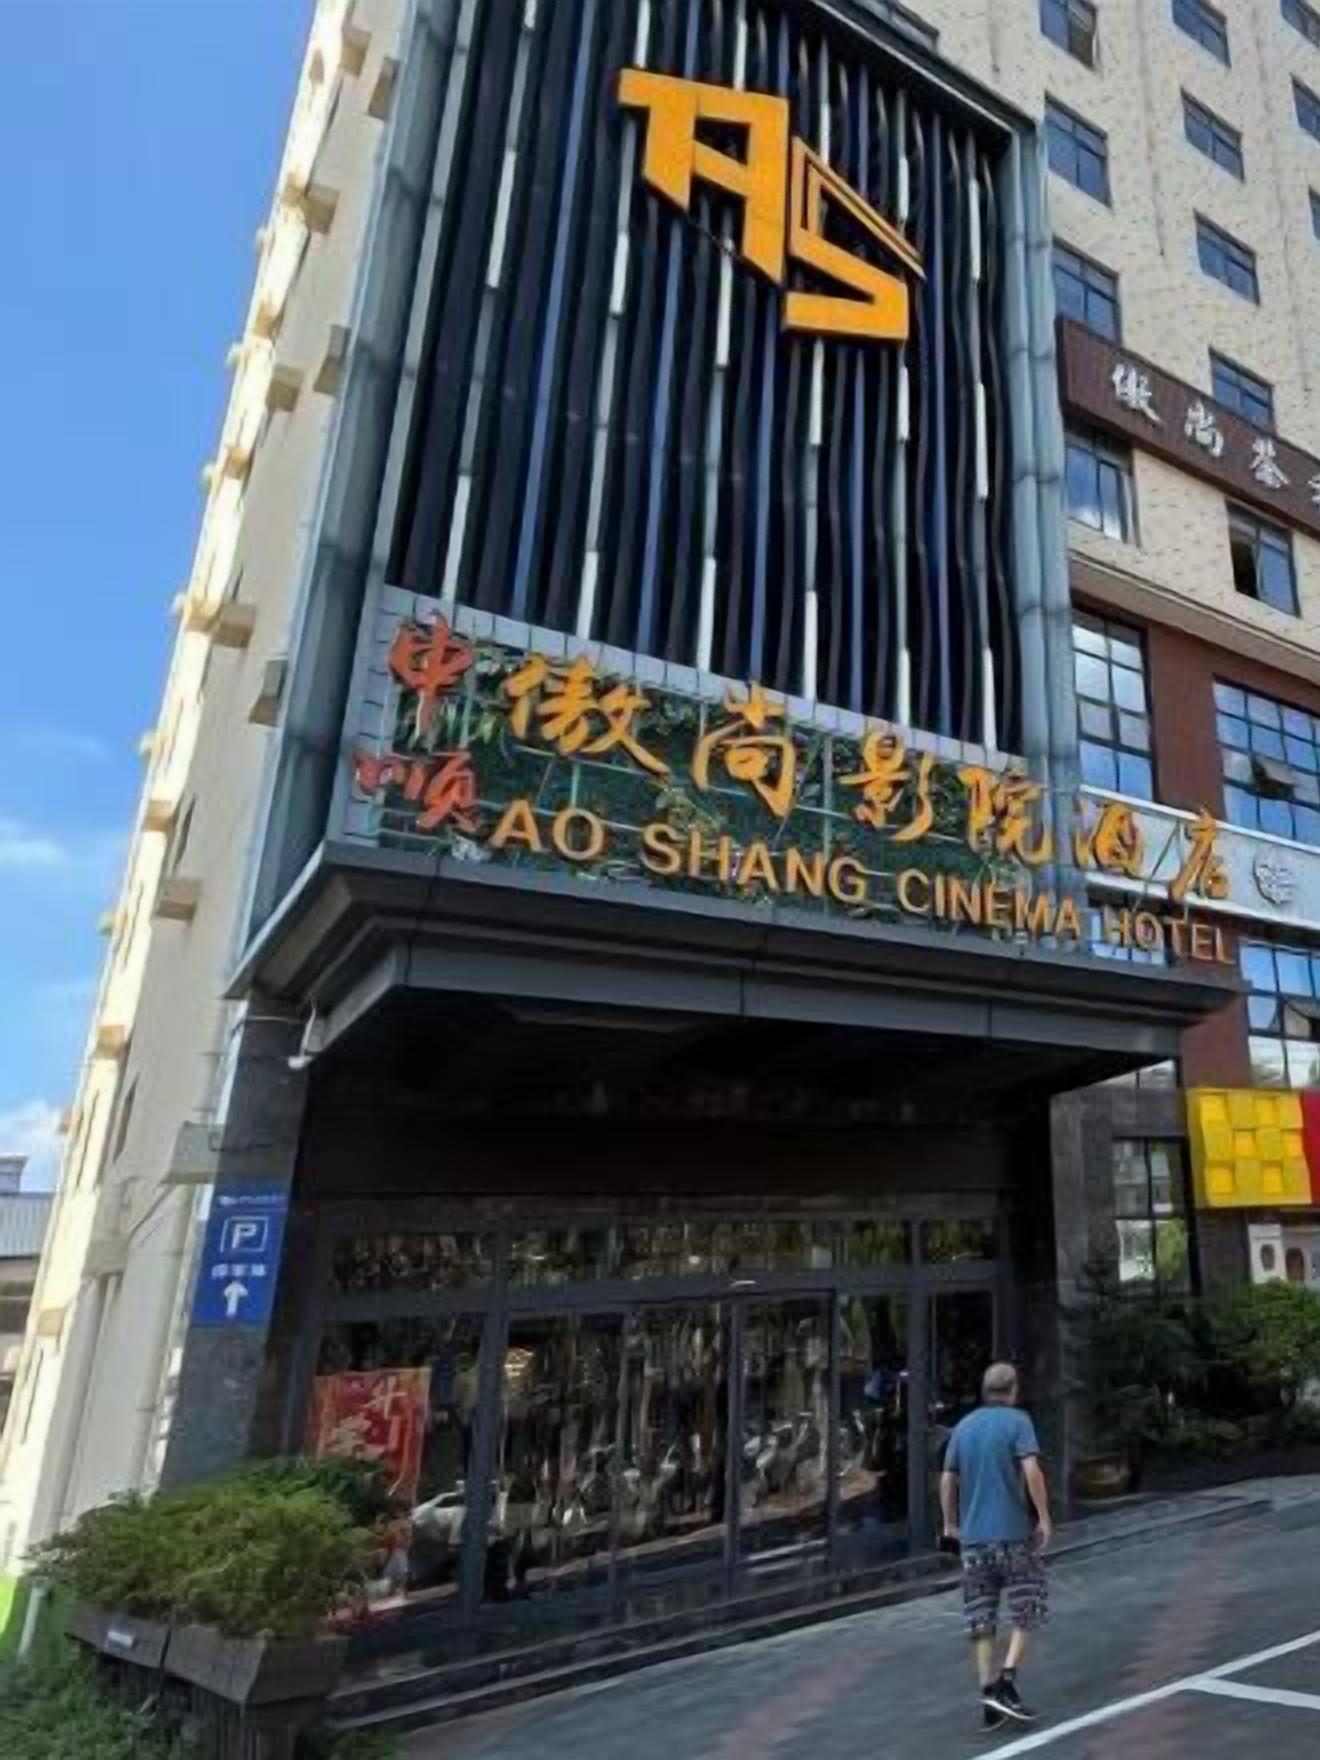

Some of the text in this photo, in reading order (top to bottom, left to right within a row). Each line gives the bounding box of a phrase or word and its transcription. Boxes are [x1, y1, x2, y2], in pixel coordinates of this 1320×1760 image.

[504, 651, 1230, 904] 傲尚影院酒店
[490, 799, 1234, 965] AO SHANG CINEMA HOTEL
[231, 1222, 258, 1250] P
